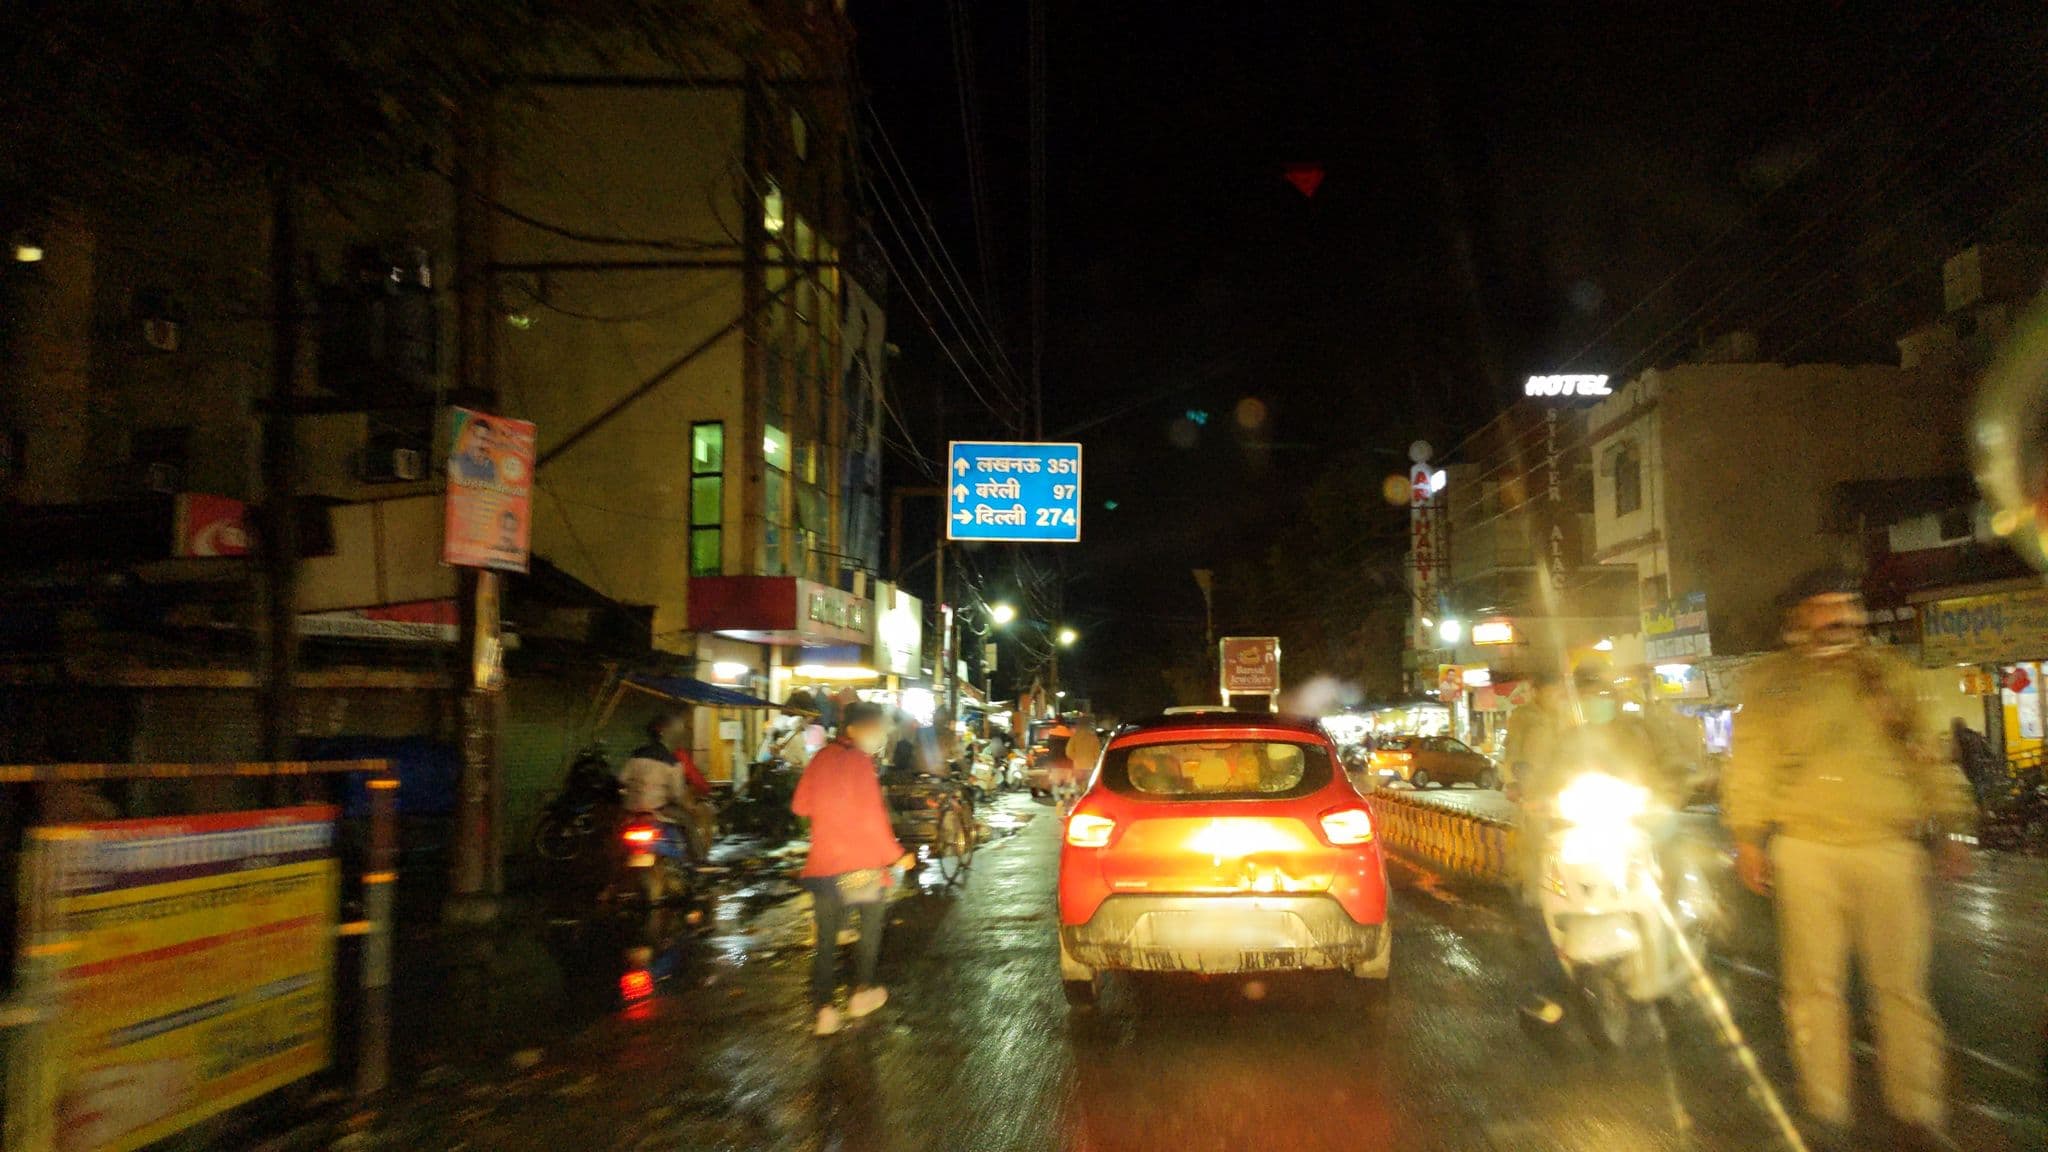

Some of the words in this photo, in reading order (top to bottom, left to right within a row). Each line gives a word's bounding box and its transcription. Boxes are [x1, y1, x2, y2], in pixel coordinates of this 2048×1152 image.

[1525, 374, 1613, 396] HOTEL
[975, 456, 1042, 473] लखनऊ
[1047, 459, 1077, 474] 351
[975, 477, 1021, 499] बरेली
[1053, 485, 1076, 500] 97
[975, 503, 1027, 526] दिल्ली
[1035, 508, 1076, 527] 274
